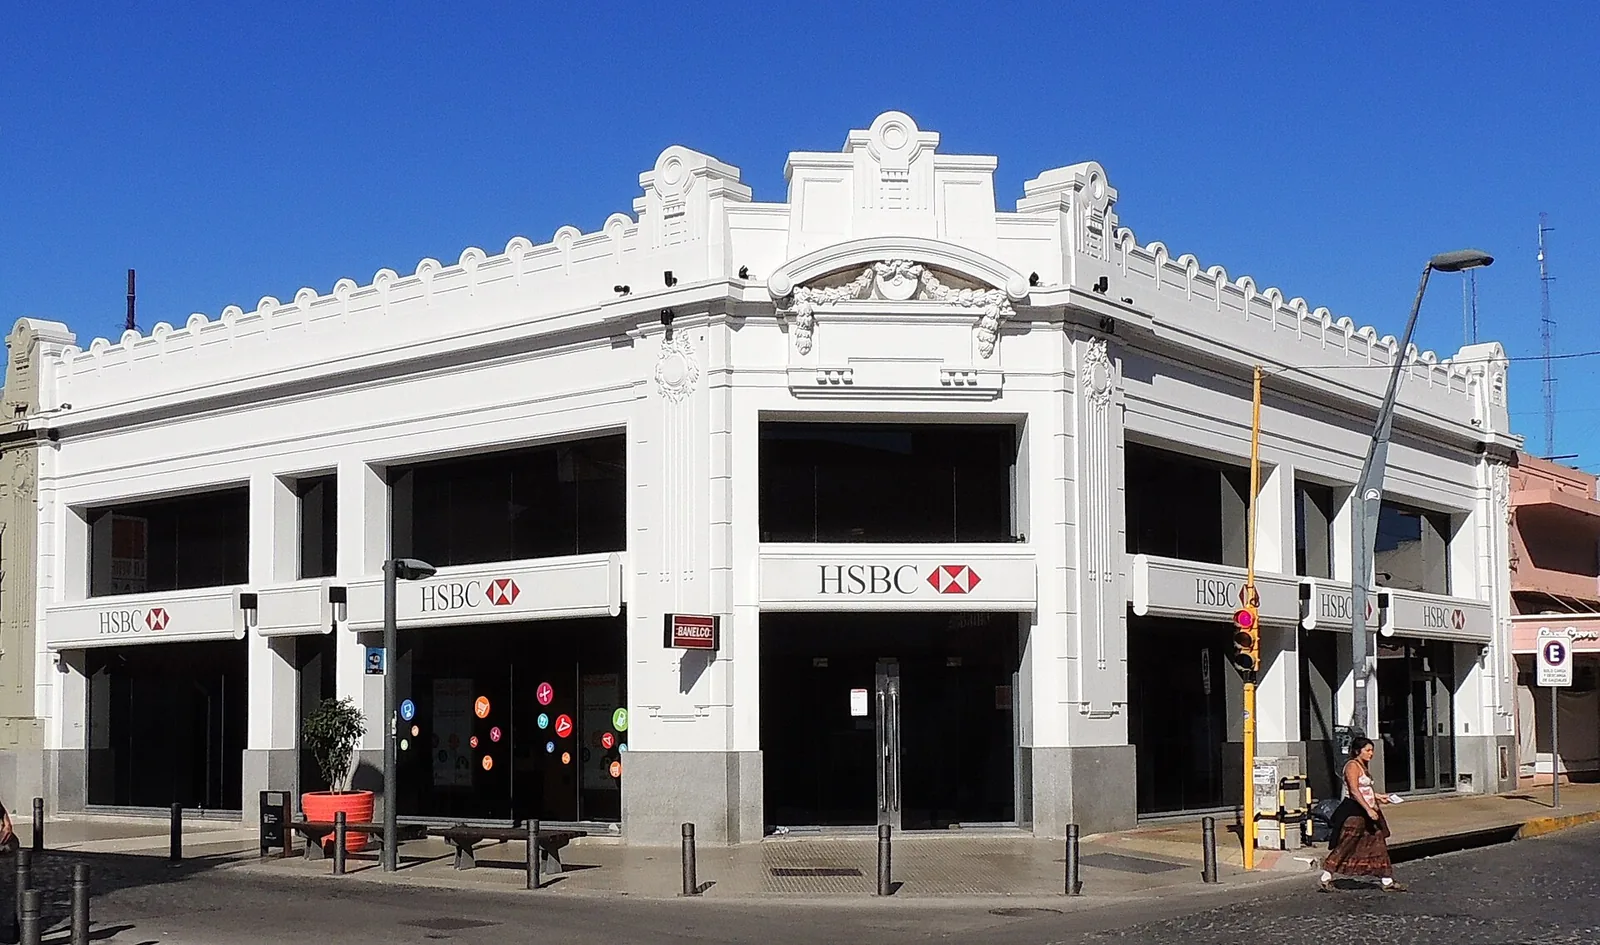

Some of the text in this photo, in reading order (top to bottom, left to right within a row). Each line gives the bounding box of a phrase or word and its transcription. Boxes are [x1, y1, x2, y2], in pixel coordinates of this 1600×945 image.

[817, 564, 919, 595] HSBC
[421, 581, 481, 612] HSBC
[1195, 578, 1237, 608] HSBC
[99, 610, 142, 634] HSBC
[1423, 605, 1450, 629] HSBC
[677, 626, 710, 638] BANELCO
[1549, 644, 1560, 662] E
